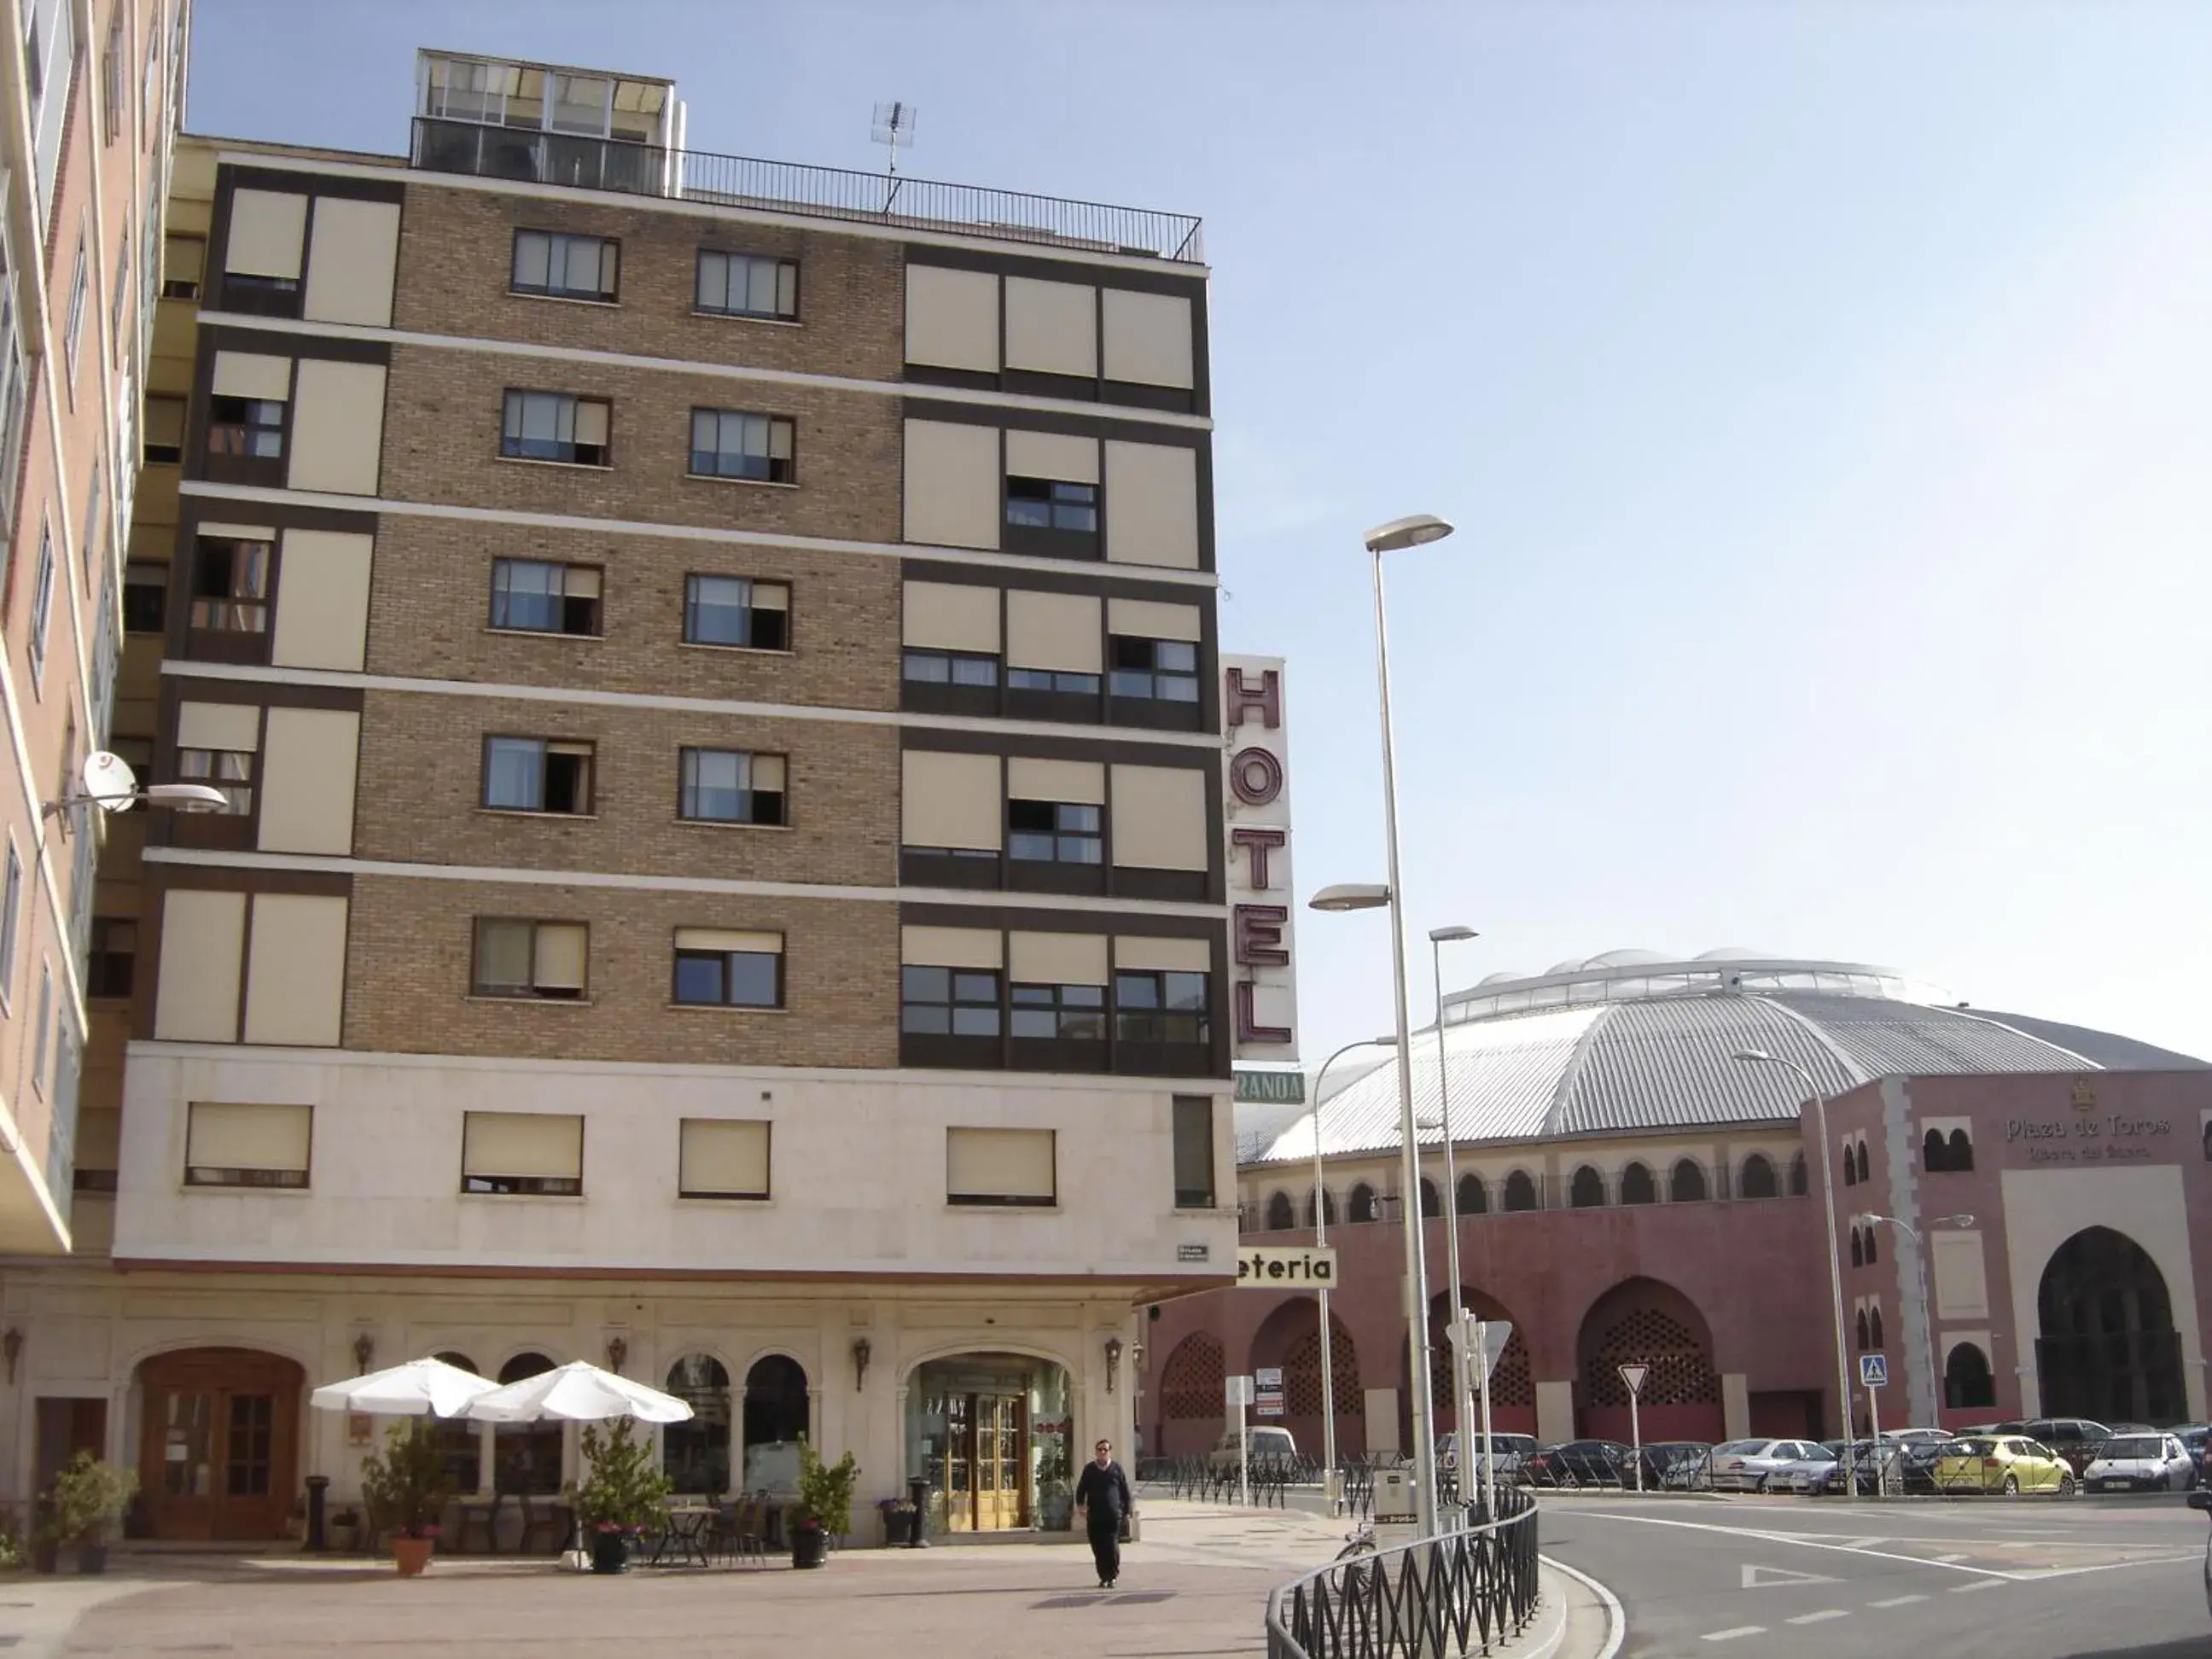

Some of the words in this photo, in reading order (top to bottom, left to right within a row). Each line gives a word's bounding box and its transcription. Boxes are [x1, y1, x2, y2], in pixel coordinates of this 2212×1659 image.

[1226, 667, 1292, 1044] HOTEL
[2075, 1118, 2098, 1138] de
[2107, 1115, 2170, 1138] Toros
[1237, 1253, 1331, 1279] eteria
